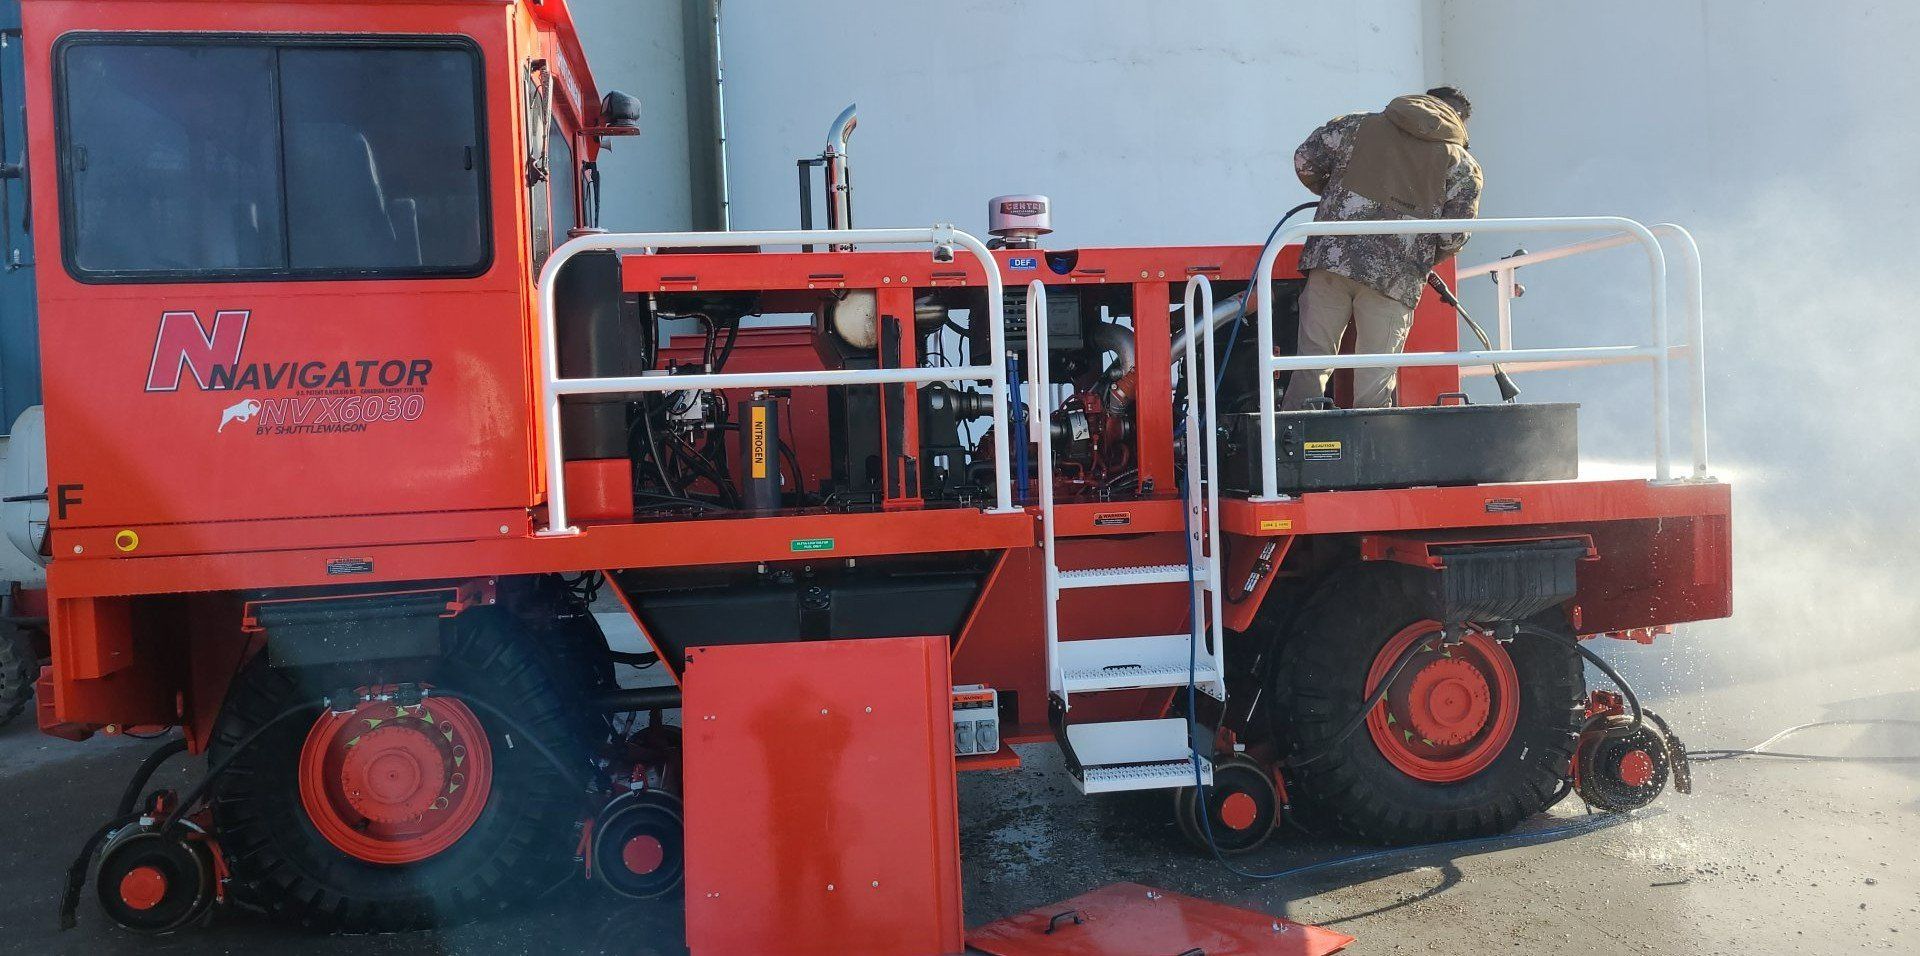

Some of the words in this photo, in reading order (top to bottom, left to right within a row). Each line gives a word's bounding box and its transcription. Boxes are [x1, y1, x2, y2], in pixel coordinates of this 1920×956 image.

[1014, 259, 1031, 267] DEF
[144, 310, 252, 392] N
[208, 359, 433, 391] NAVIGATOR
[259, 395, 425, 426] NVX6030
[256, 426, 272, 435] BY
[275, 423, 367, 435] SHUTTLEWAGON
[754, 421, 763, 464] NITROGEN
[58, 484, 84, 520] F
